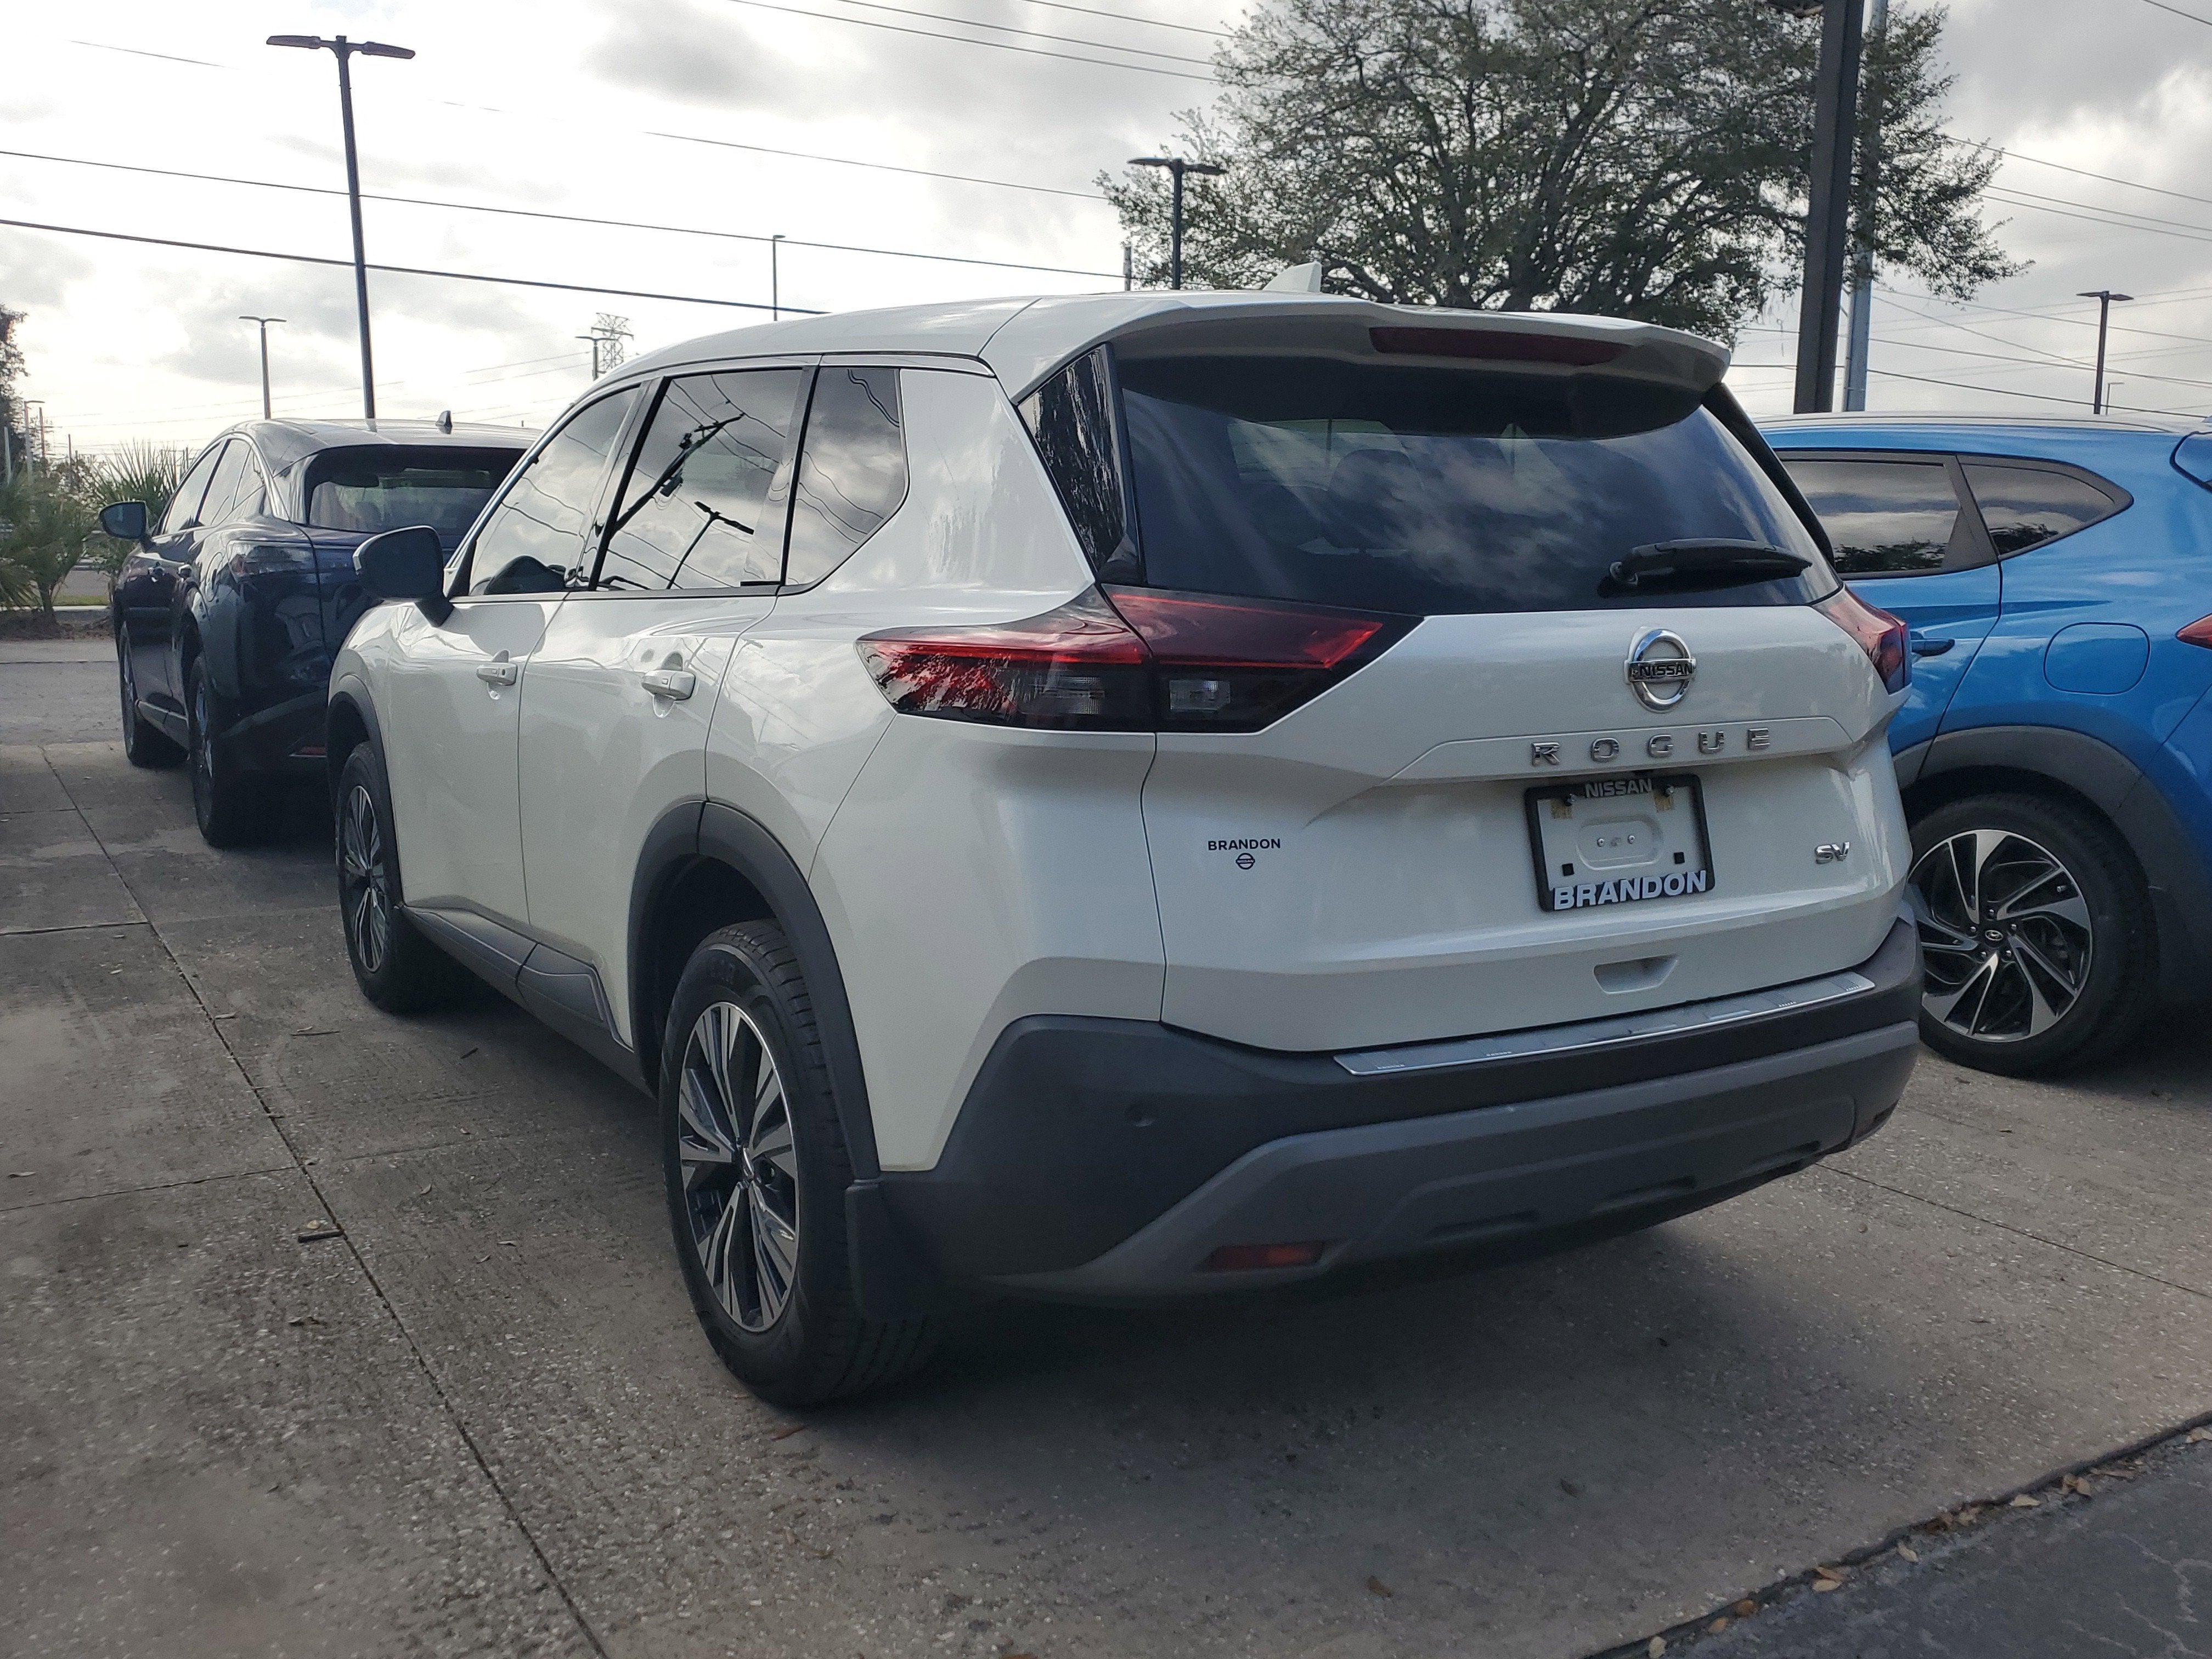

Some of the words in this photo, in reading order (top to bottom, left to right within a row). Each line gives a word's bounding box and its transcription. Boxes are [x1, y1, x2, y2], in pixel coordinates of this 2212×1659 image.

[1639, 663, 1692, 676] NISSAN
[1532, 728, 1770, 765] ROGUE
[1585, 778, 1652, 798] NISSAN
[1207, 838, 1280, 851] BRANDON
[1815, 841, 1850, 864] SV
[1554, 870, 1707, 910] BRANDON
